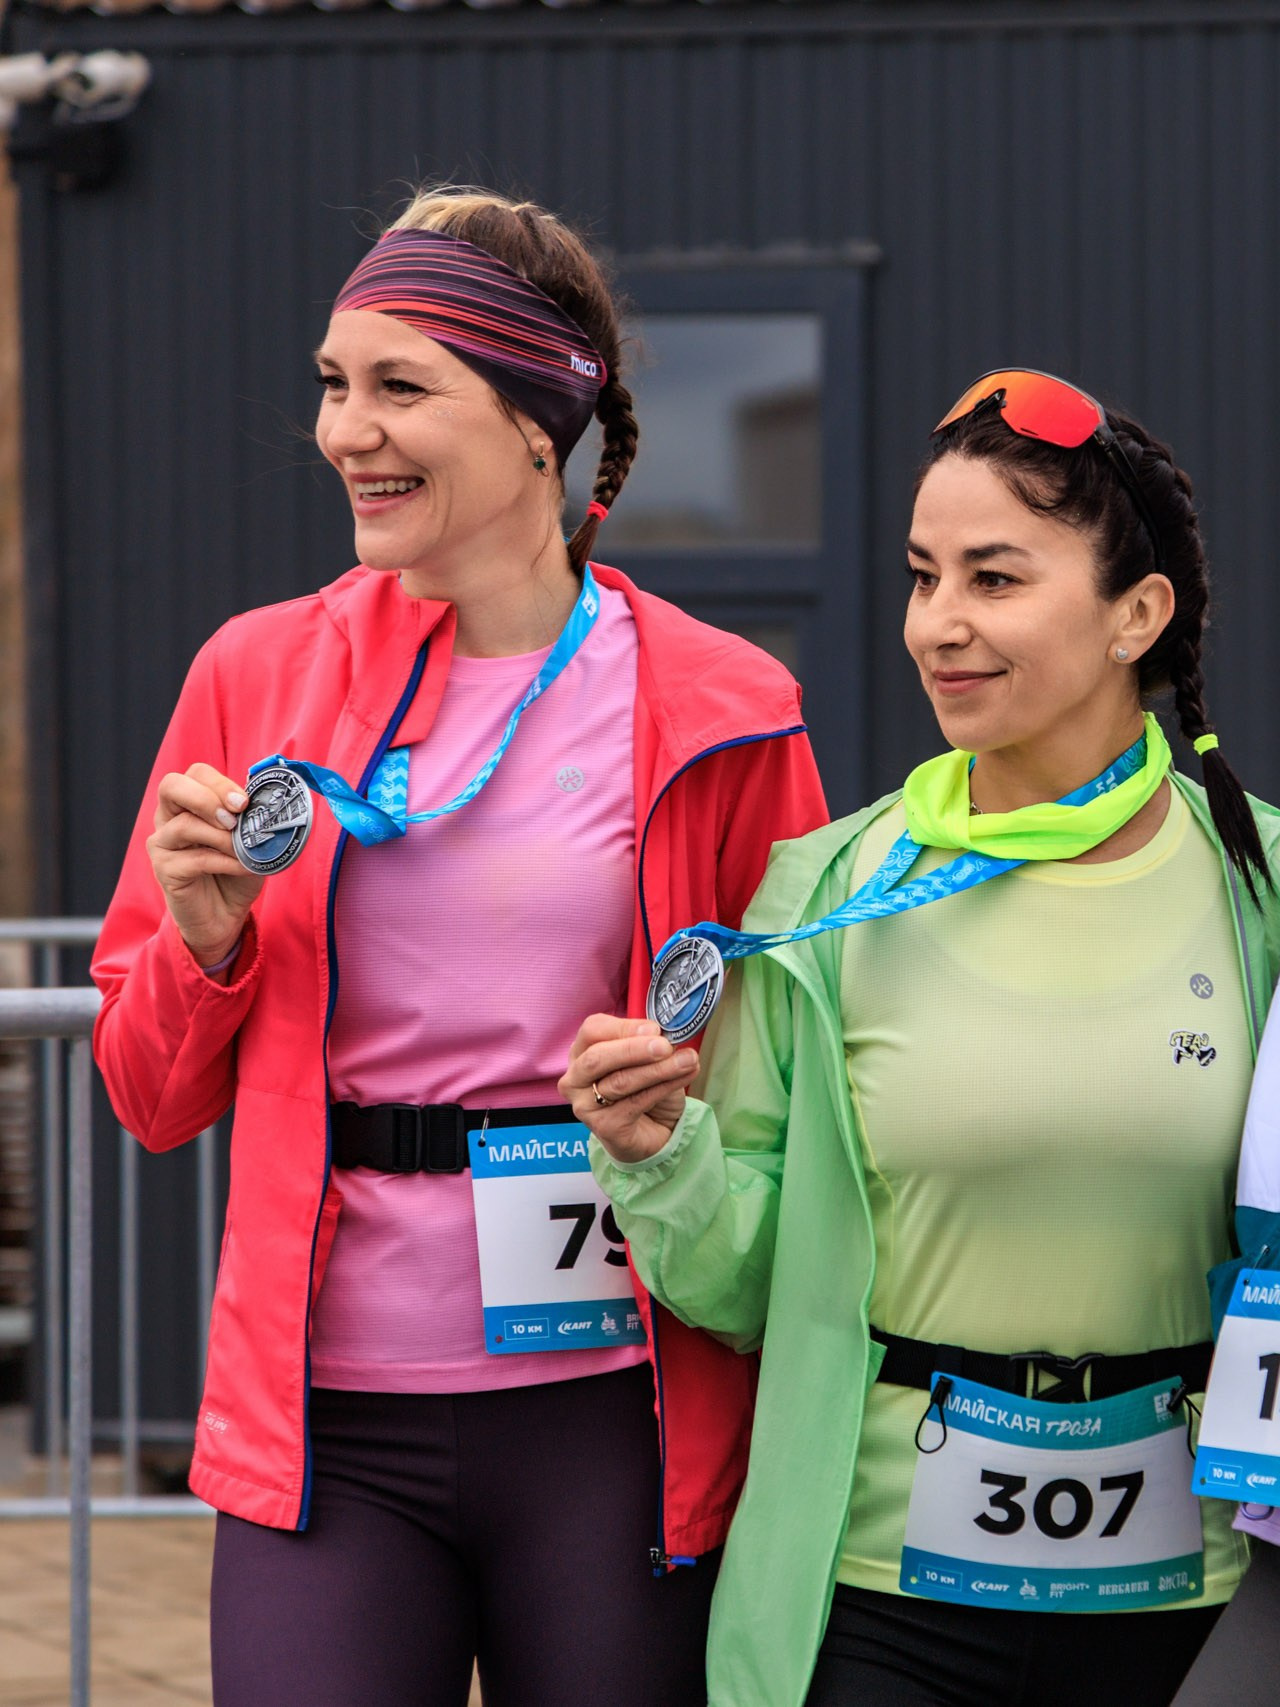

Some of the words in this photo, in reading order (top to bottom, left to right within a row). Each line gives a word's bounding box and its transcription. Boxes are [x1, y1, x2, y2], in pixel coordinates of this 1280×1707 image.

[489, 1139, 590, 1163] МАЙСКА
[512, 1324, 525, 1334] 10
[528, 1325, 543, 1333] КМ
[943, 1393, 1040, 1435] МАЙСКАЯ
[1045, 1417, 1102, 1437] ГРОЗА
[1212, 1467, 1223, 1479] 10
[973, 1468, 1145, 1540] 307
[926, 1570, 938, 1582] 10
[1050, 1582, 1086, 1591] BRIGHT
